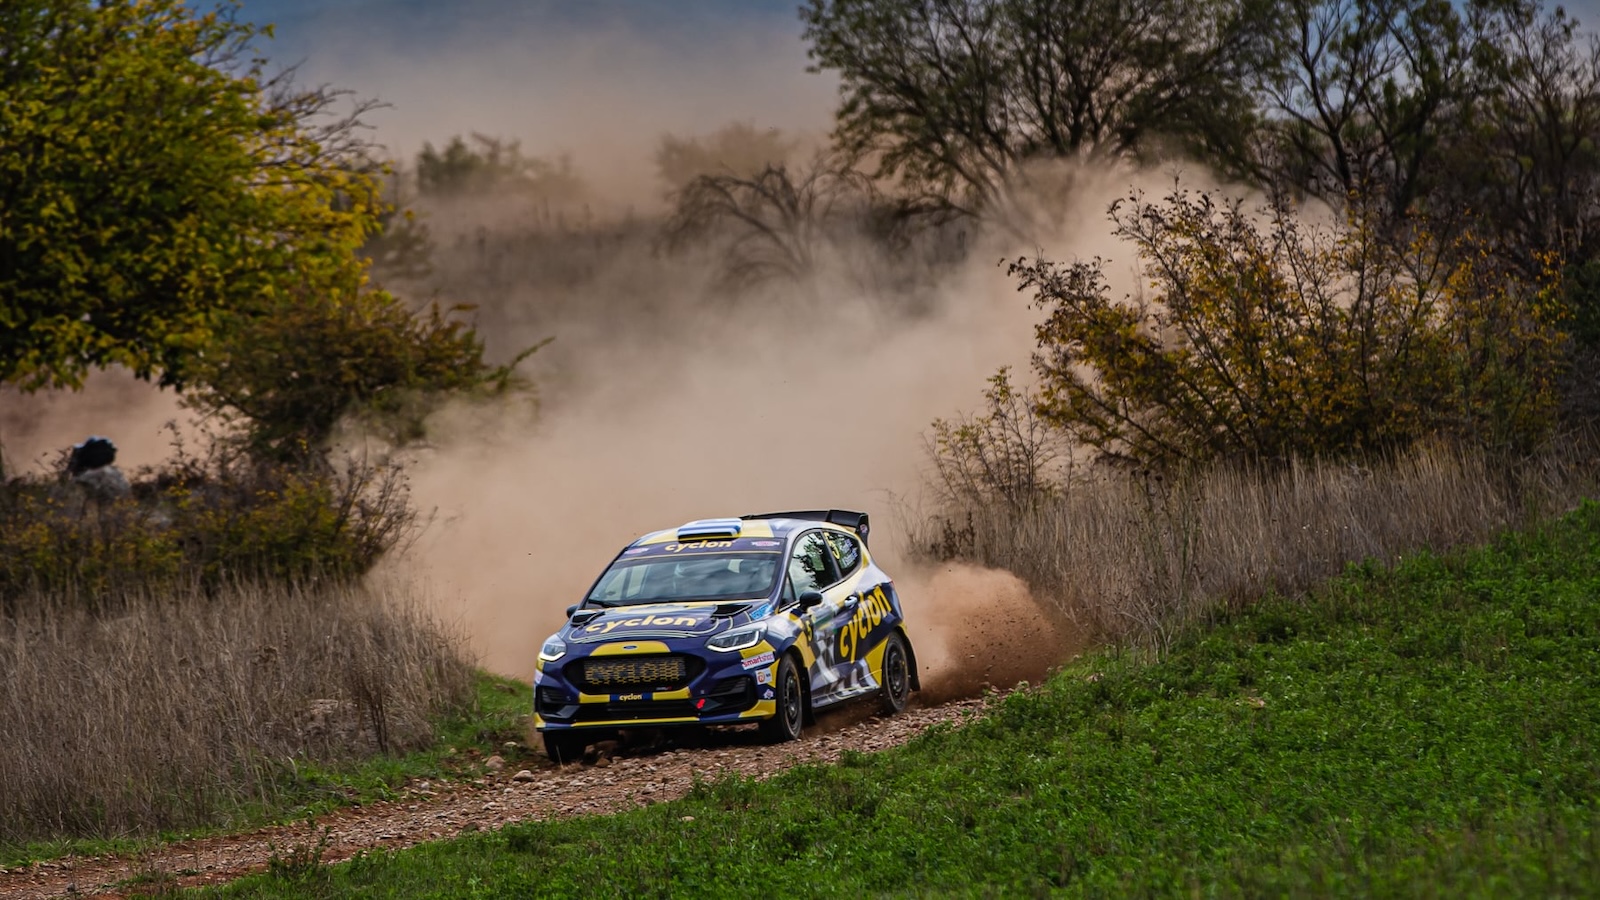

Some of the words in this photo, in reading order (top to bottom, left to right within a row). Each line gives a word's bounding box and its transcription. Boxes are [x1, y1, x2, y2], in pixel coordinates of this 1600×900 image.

[664, 540, 731, 552] cyclon
[585, 615, 697, 634] cyclon
[840, 585, 892, 664] cyclon
[619, 693, 643, 702] cyclon
